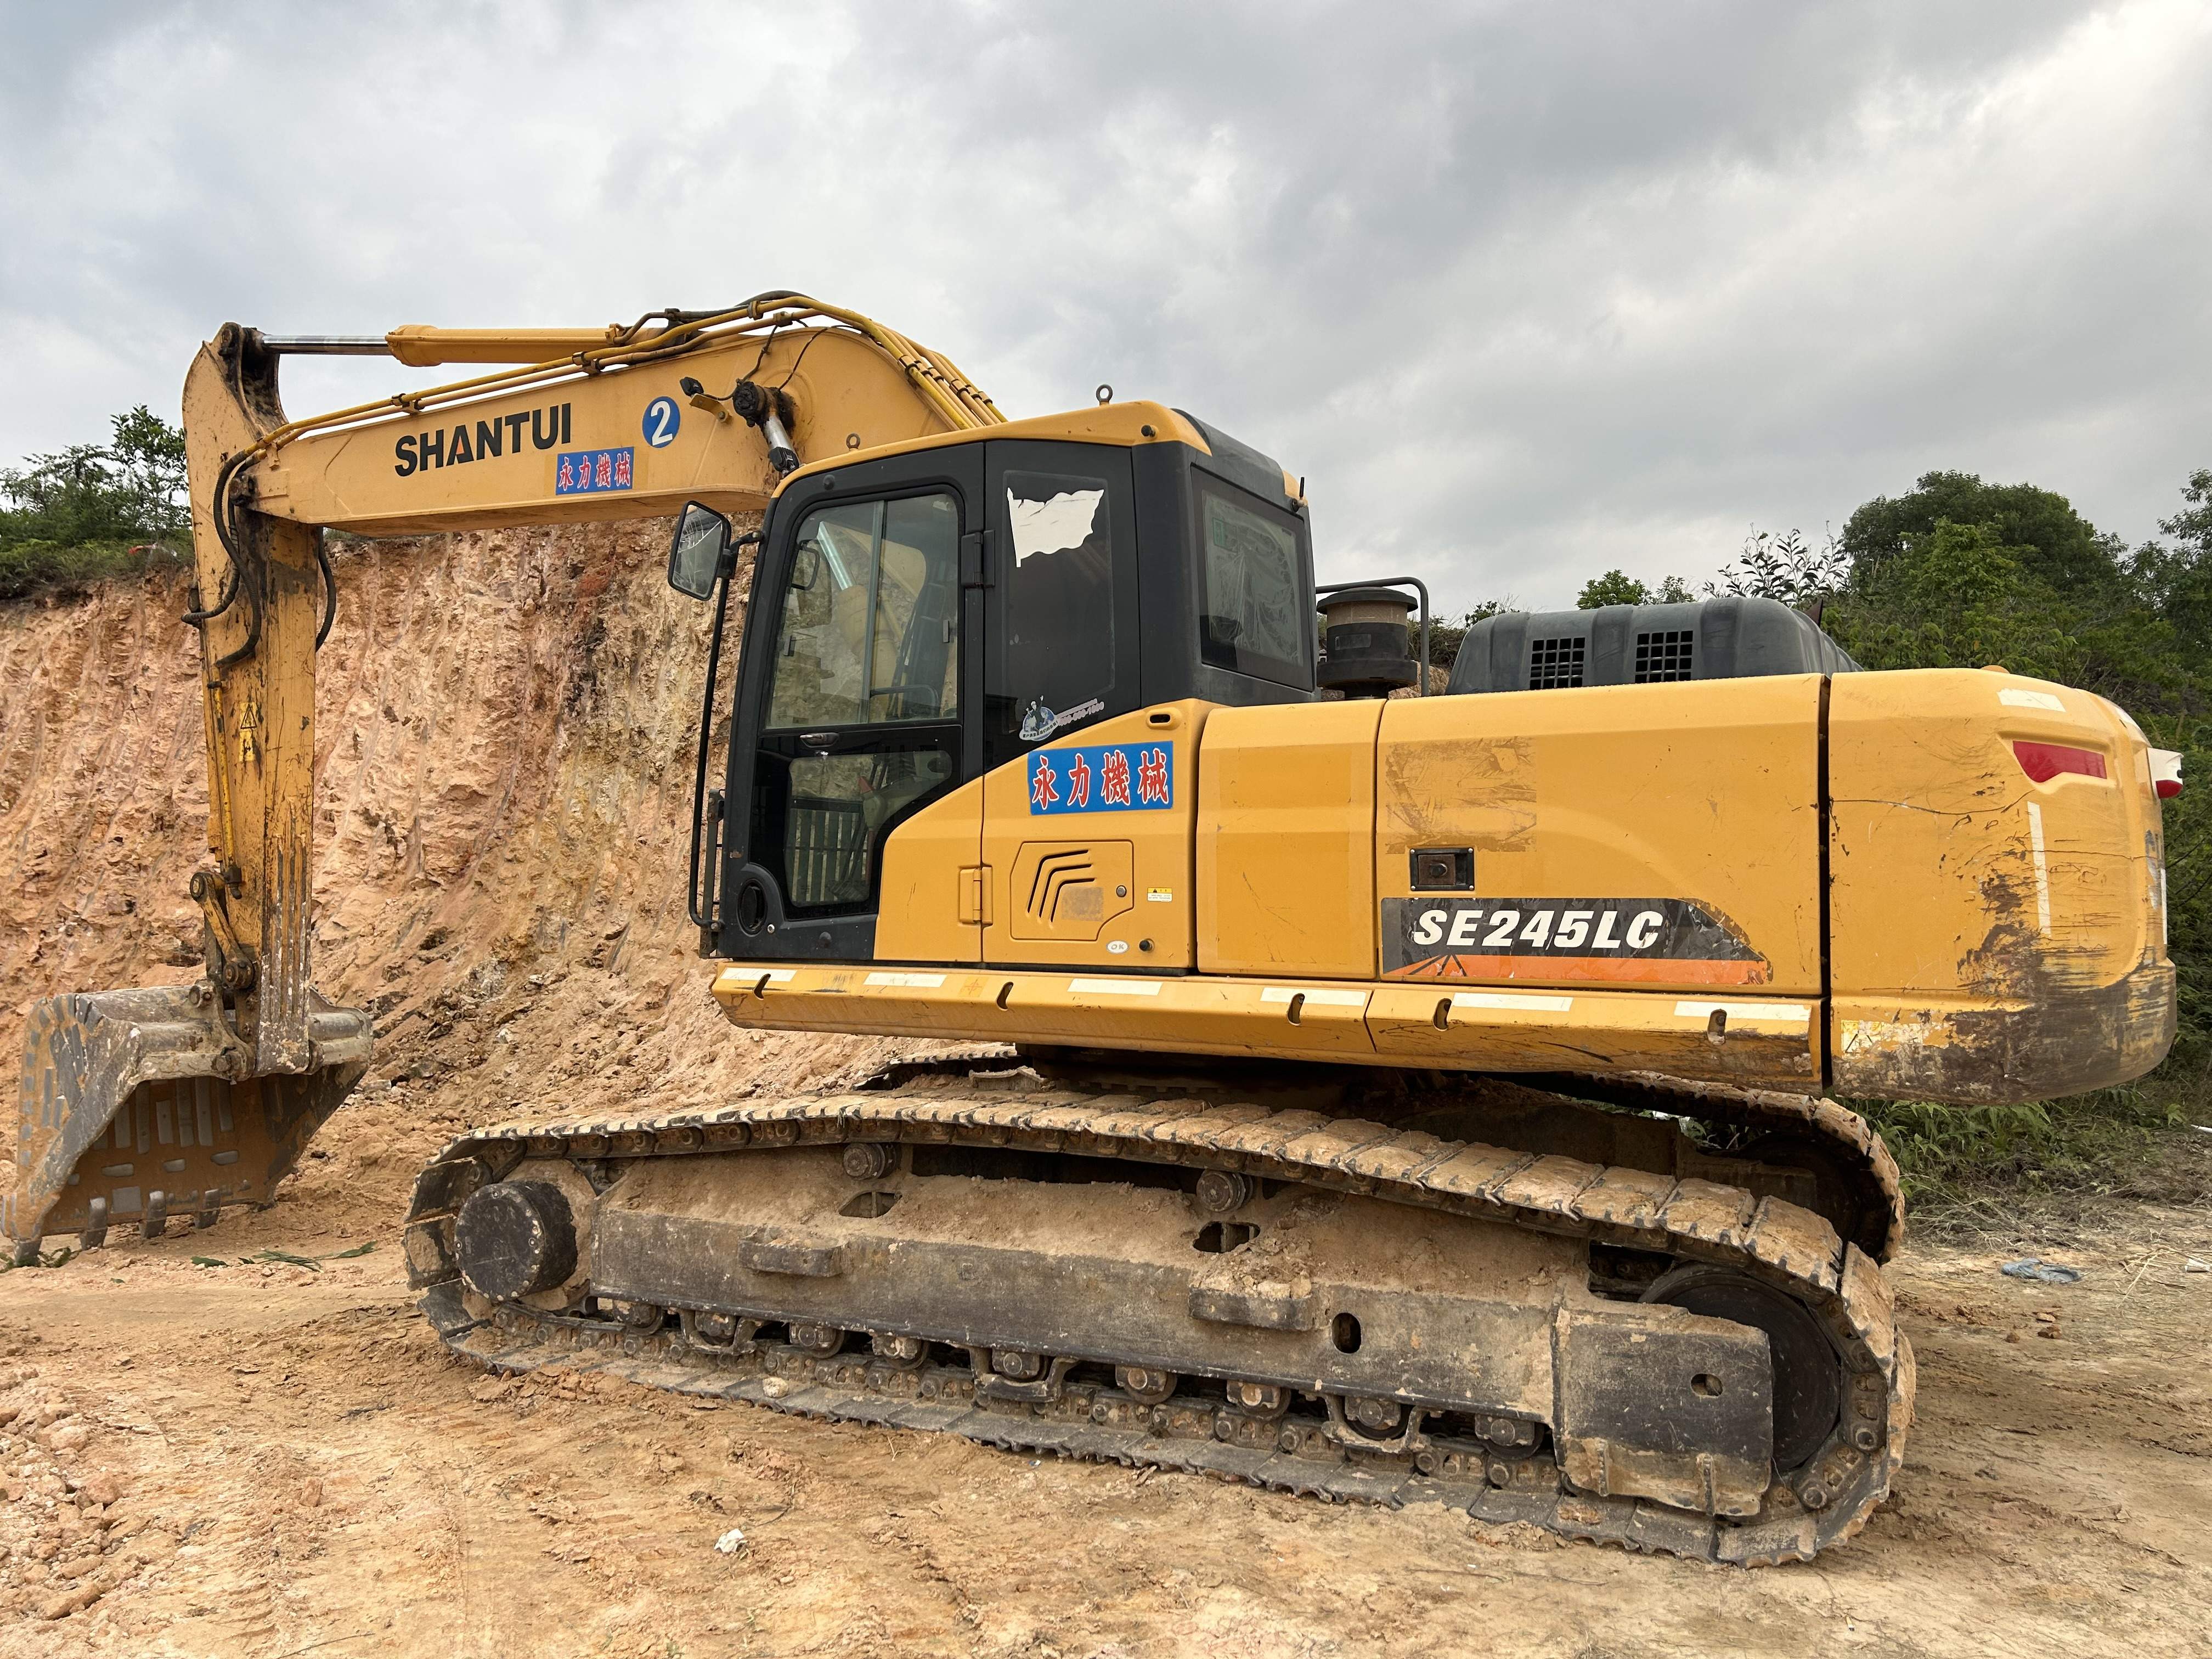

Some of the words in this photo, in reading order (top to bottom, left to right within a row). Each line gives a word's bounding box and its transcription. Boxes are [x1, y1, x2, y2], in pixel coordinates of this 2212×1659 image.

[394, 402, 571, 477] SHANTUI
[650, 400, 674, 446] 2
[557, 451, 631, 492] 永力機械
[1031, 747, 1169, 810] 永力機械
[1412, 910, 1663, 949] SE245LC
